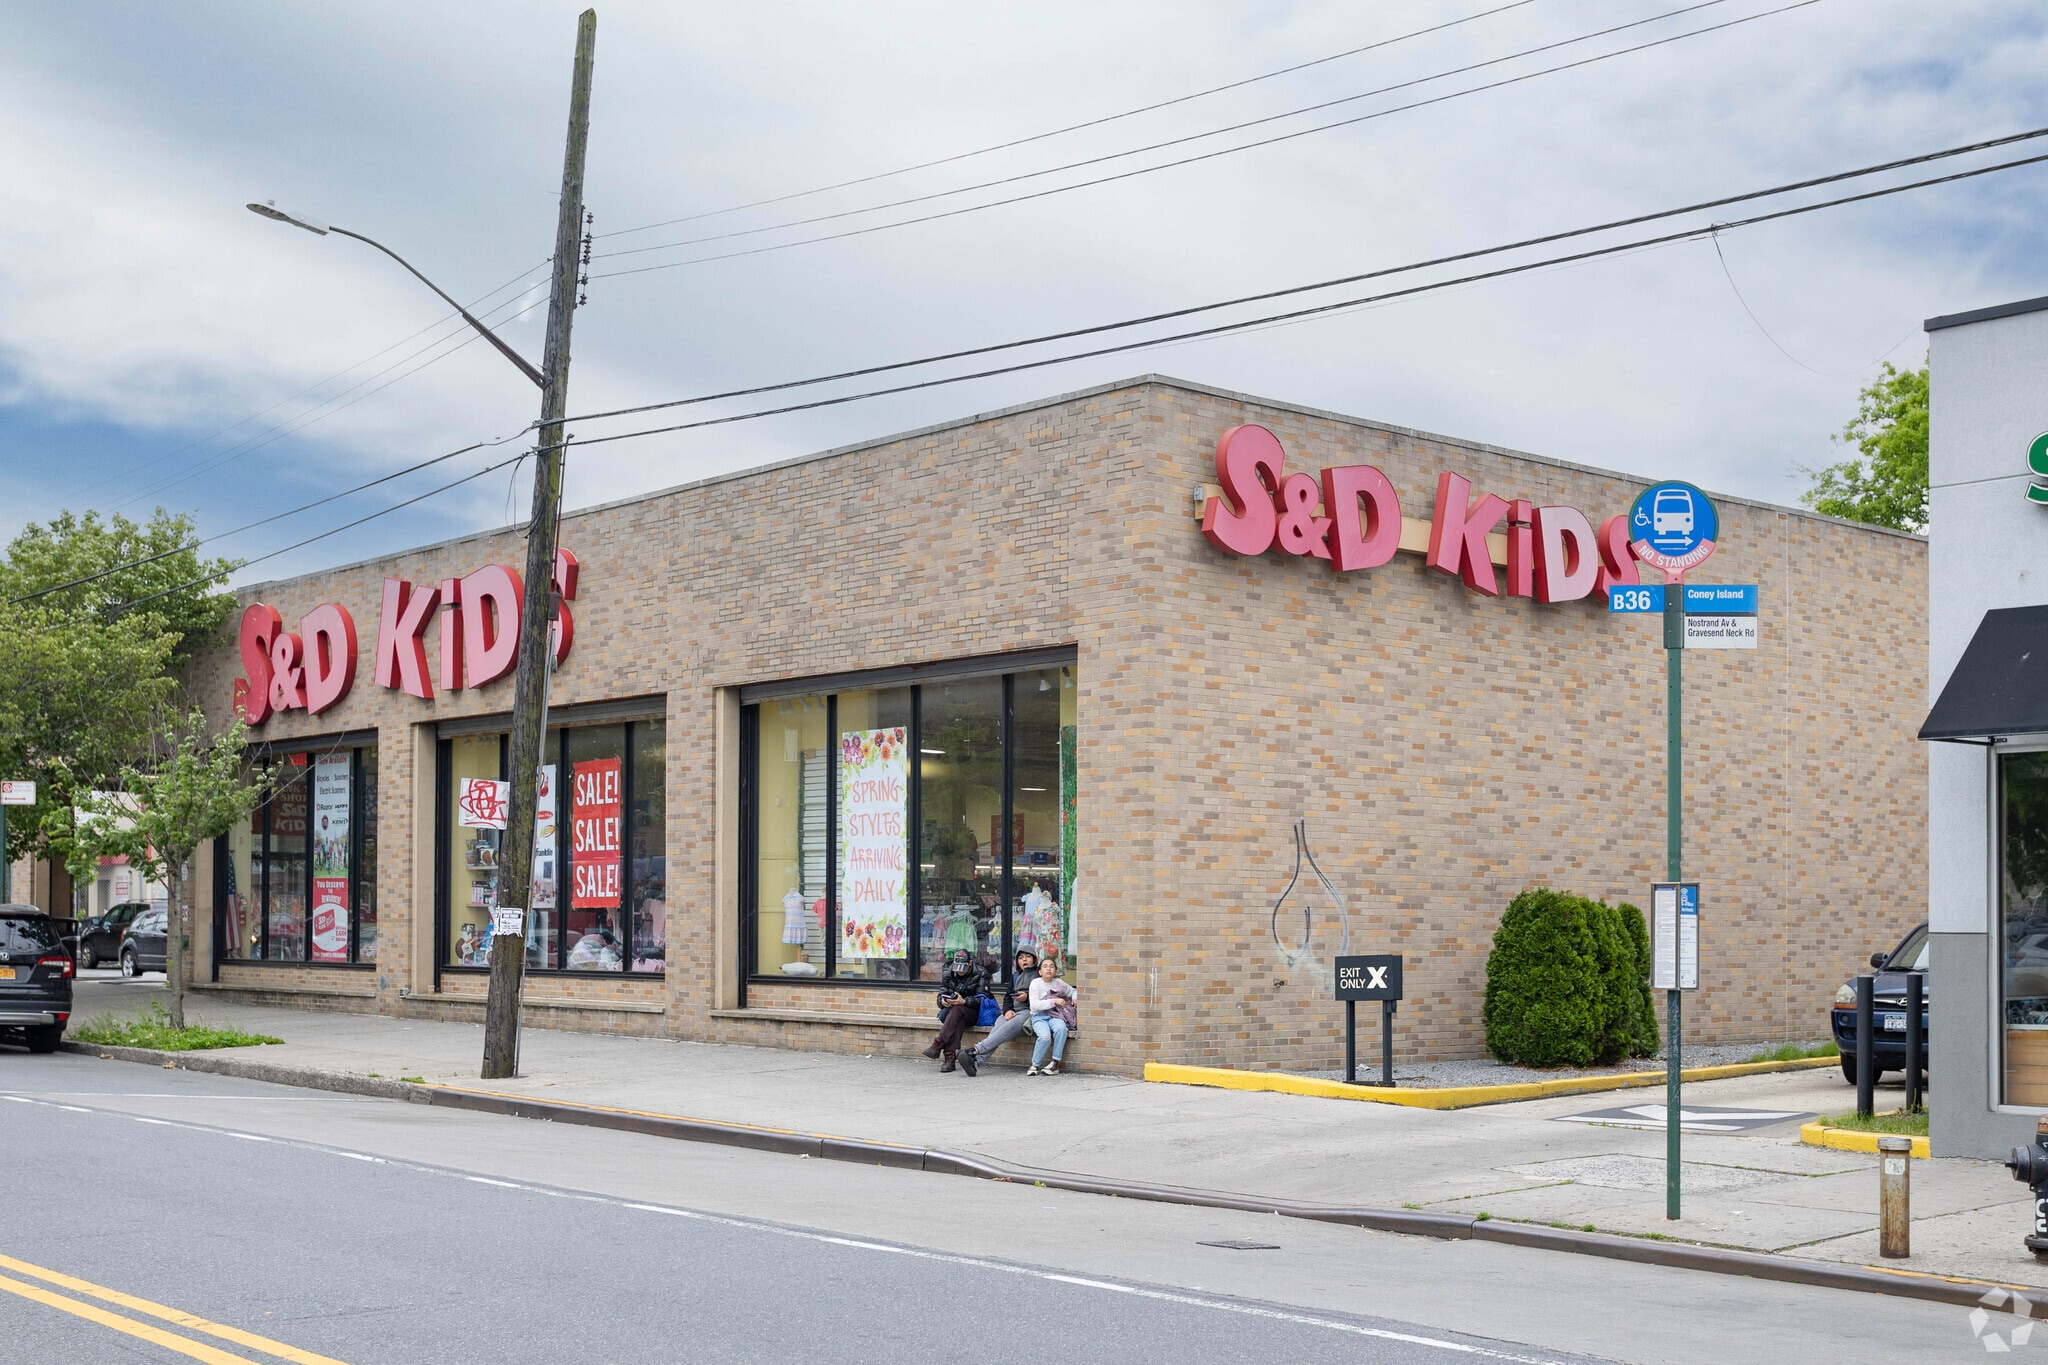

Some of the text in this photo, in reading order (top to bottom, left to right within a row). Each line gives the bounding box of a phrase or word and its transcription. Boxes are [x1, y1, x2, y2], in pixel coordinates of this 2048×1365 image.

[1202, 424, 1401, 572] S&D
[1638, 545, 1709, 568] NO STANDING
[1613, 591, 1651, 610] B36
[1687, 589, 1744, 601] Coney Island
[1687, 618, 1737, 627] Nostrand Av &
[1687, 628, 1755, 637] Gravesend Neck Rd
[233, 602, 358, 726] S&D
[576, 770, 619, 806] SALE!
[852, 776, 899, 804] SPRING
[575, 817, 619, 852] SALE!
[849, 811, 901, 836] STYLES
[849, 844, 902, 871] ARRIVING
[576, 864, 619, 898] SALE!
[854, 877, 896, 903] DAILY
[1340, 967, 1361, 978] EXIT
[1340, 978, 1366, 989] ONLY
